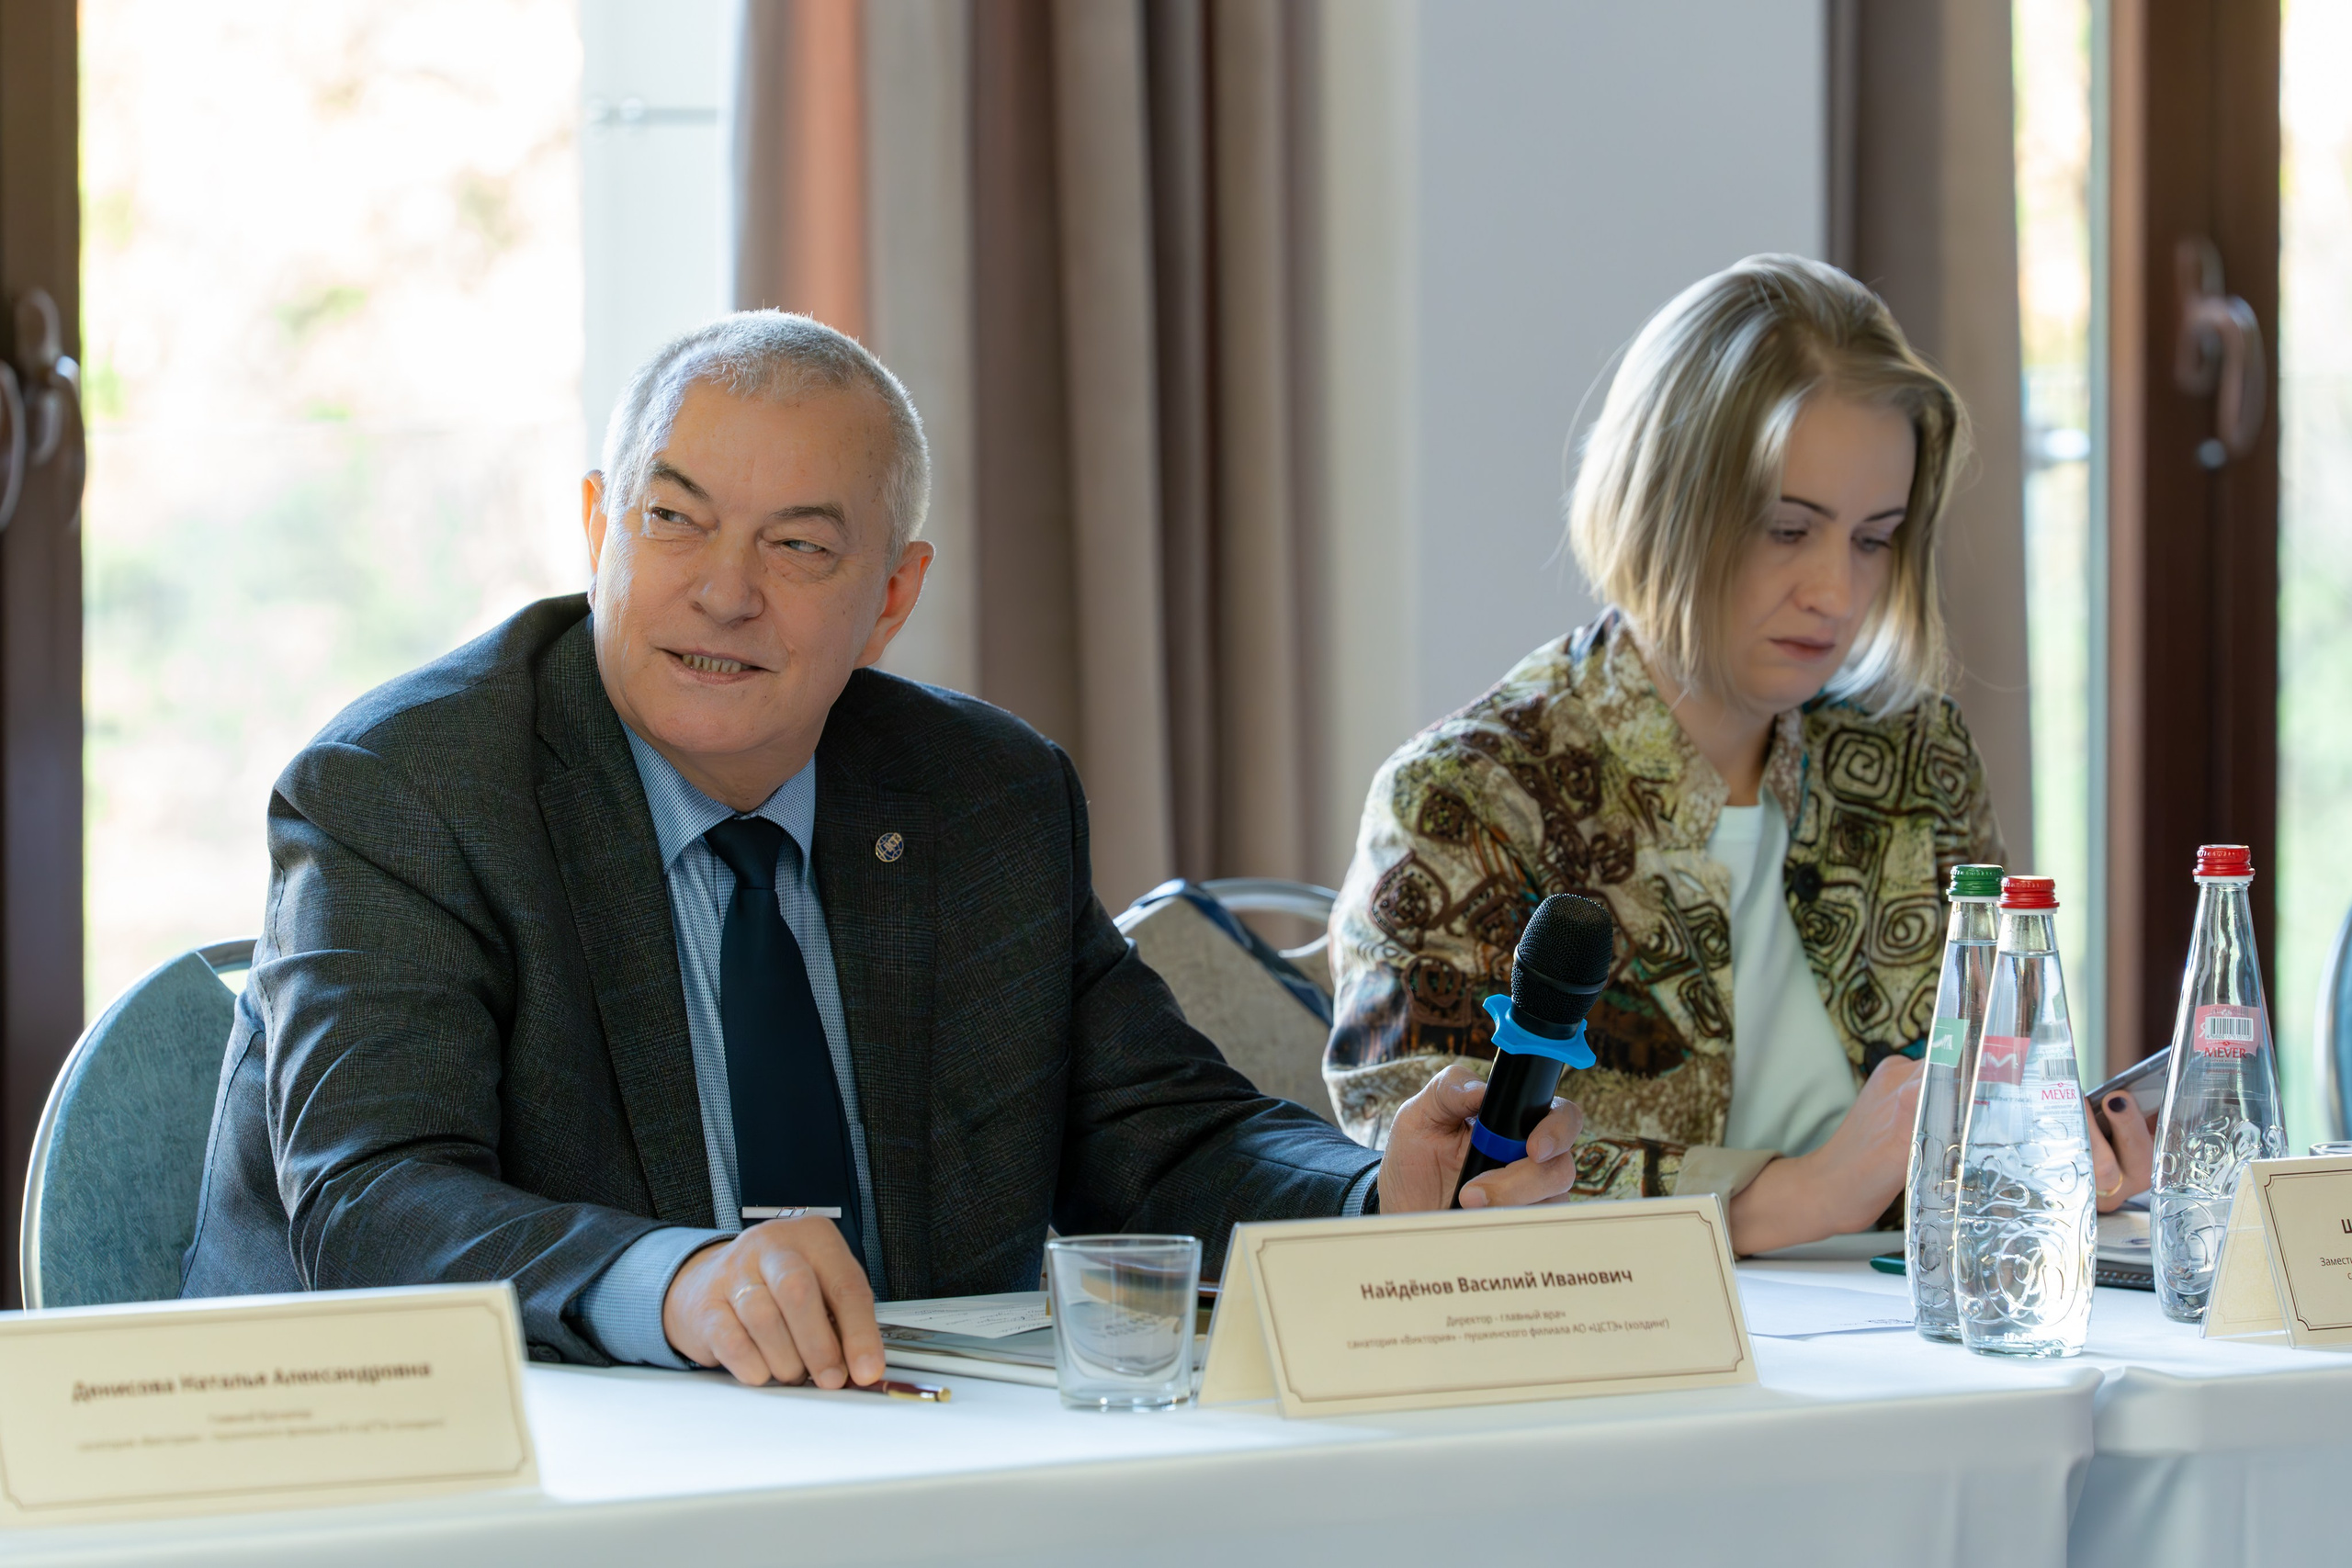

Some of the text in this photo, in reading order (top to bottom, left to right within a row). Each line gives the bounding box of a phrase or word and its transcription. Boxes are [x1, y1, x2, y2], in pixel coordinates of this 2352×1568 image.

[2204, 1046, 2248, 1058] MEVER
[2041, 1089, 2076, 1100] MEVER
[1361, 1269, 1634, 1301] Найдёнов Василий Иванович
[1446, 1314, 1493, 1327] Директор
[1500, 1309, 1541, 1322] главный
[1543, 1310, 1566, 1322] врач
[1529, 1325, 1571, 1338] филиала
[1572, 1323, 1587, 1334] АО
